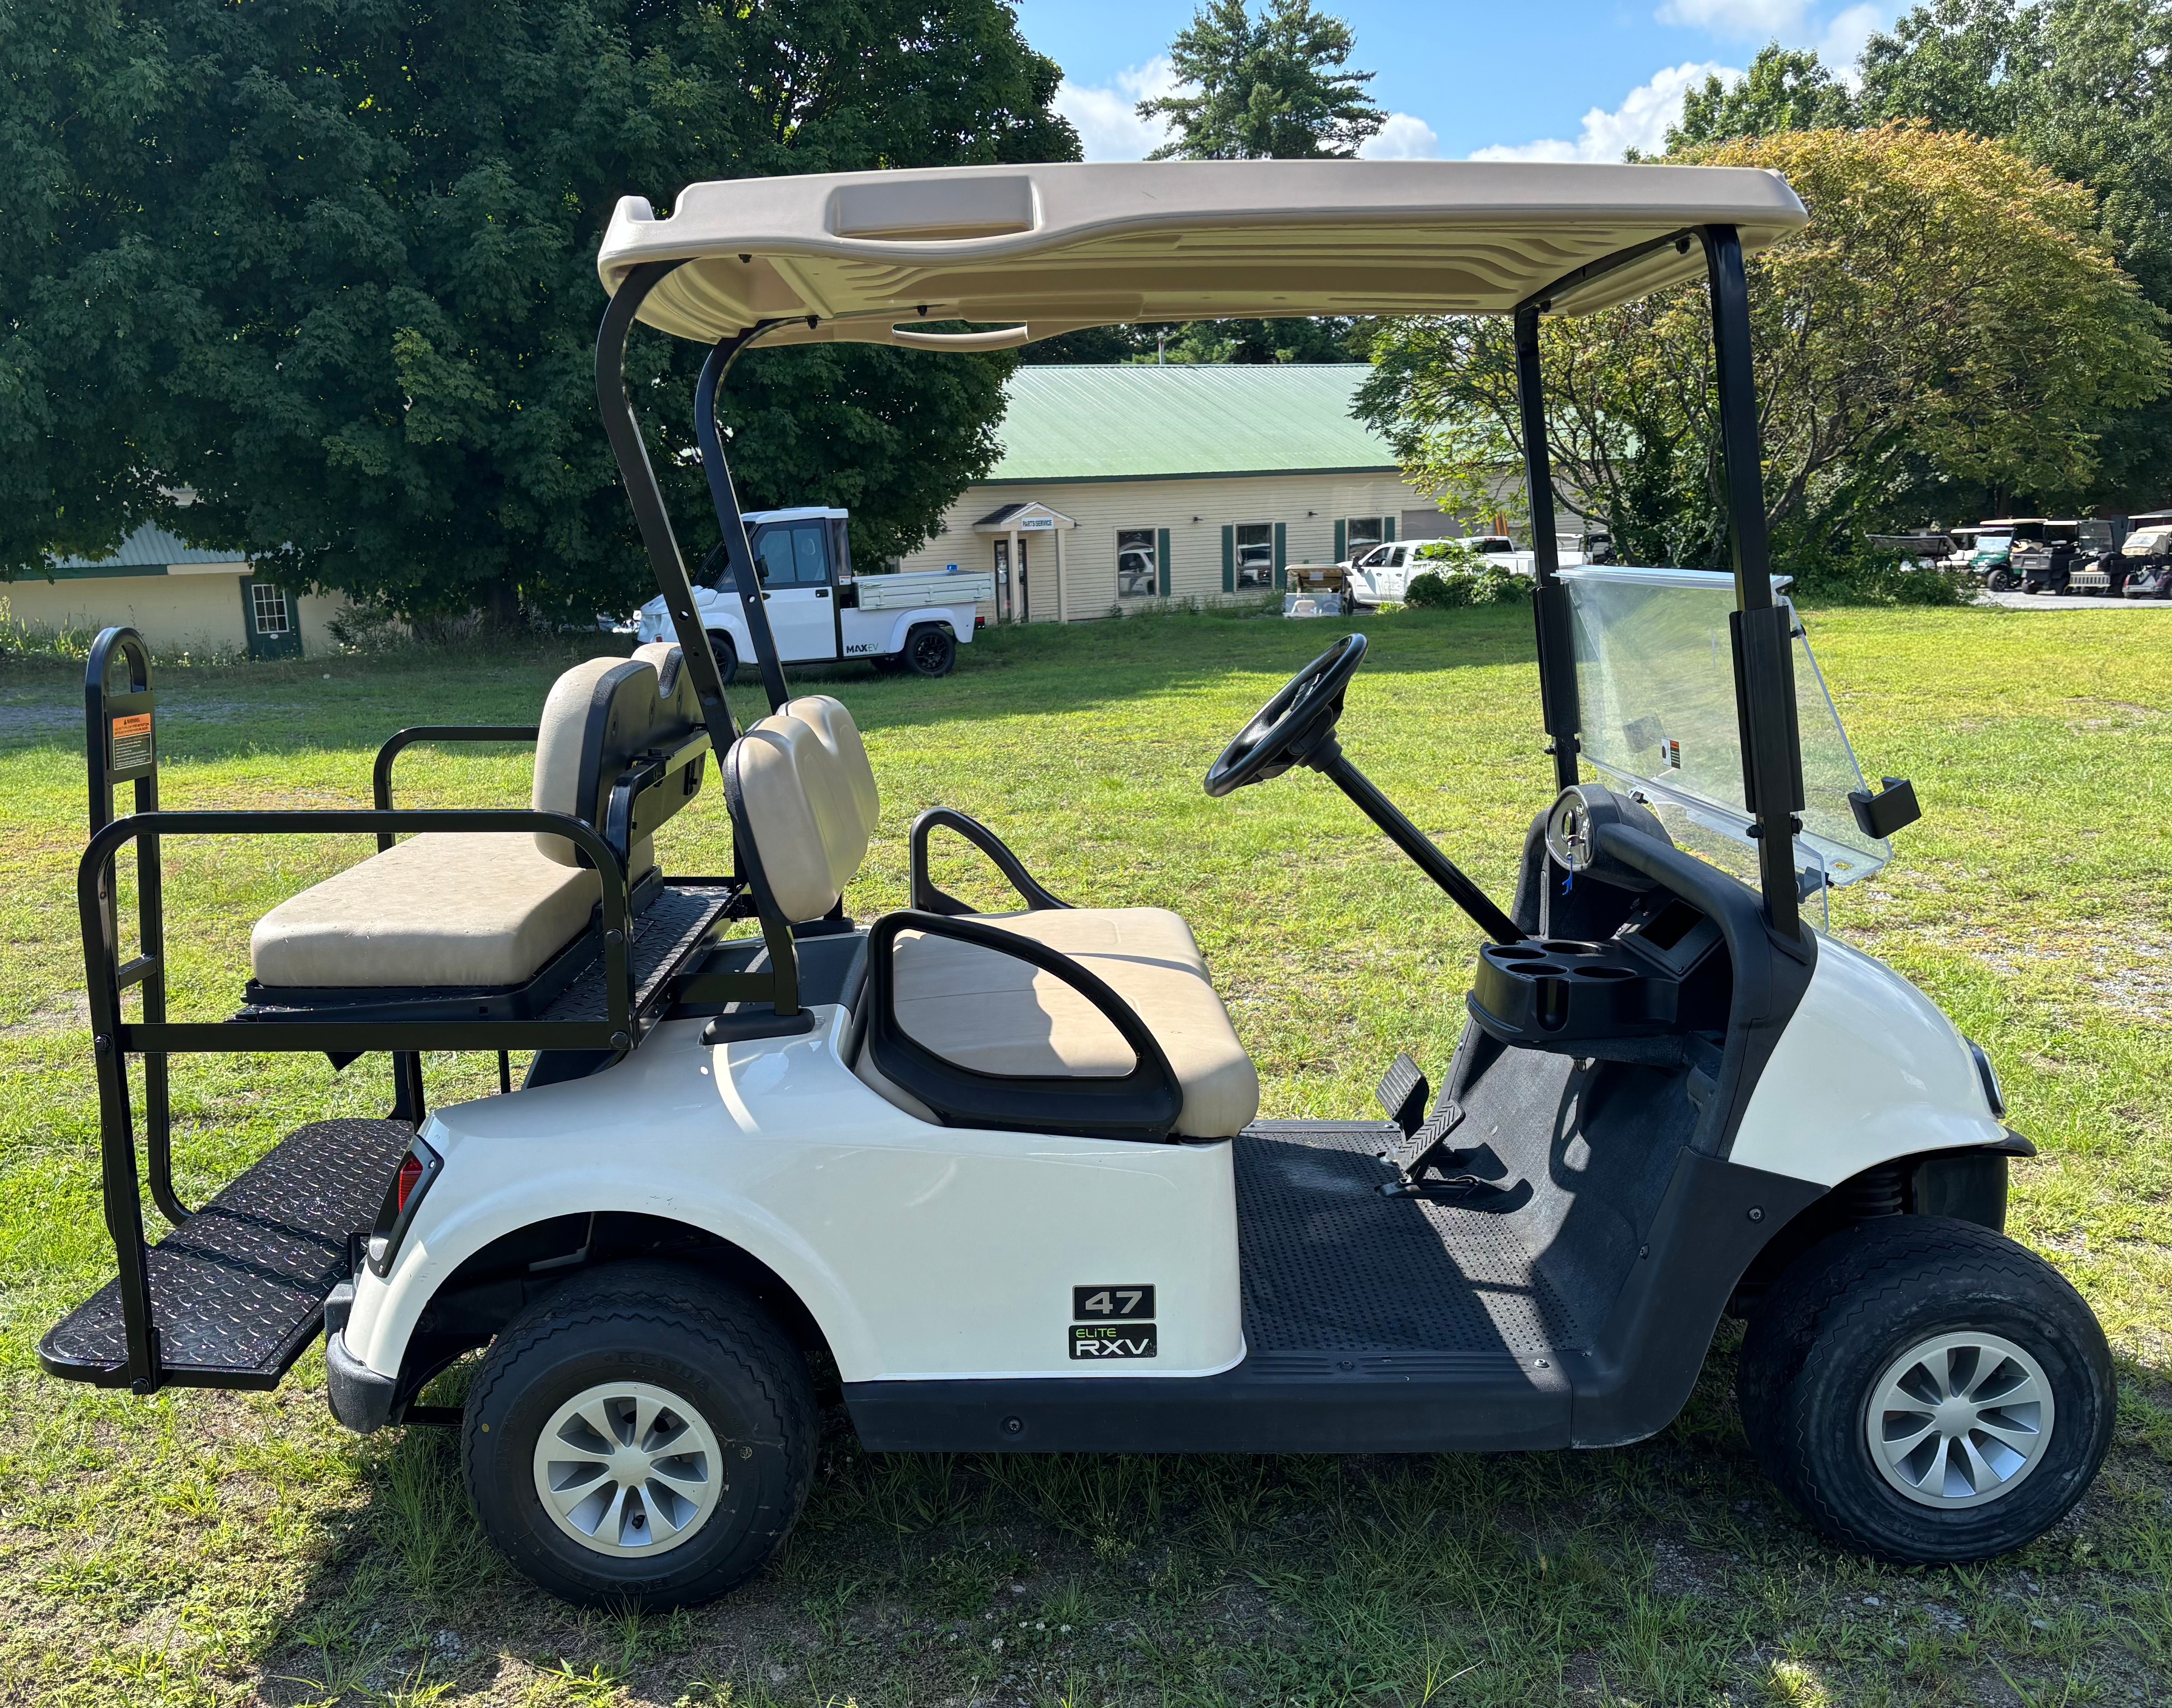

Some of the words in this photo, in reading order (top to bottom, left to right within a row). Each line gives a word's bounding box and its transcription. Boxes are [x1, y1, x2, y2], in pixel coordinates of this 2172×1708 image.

[1085, 1291, 1142, 1314] 47
[1076, 1338, 1150, 1356] RXV
[617, 1351, 711, 1393] KENDA
